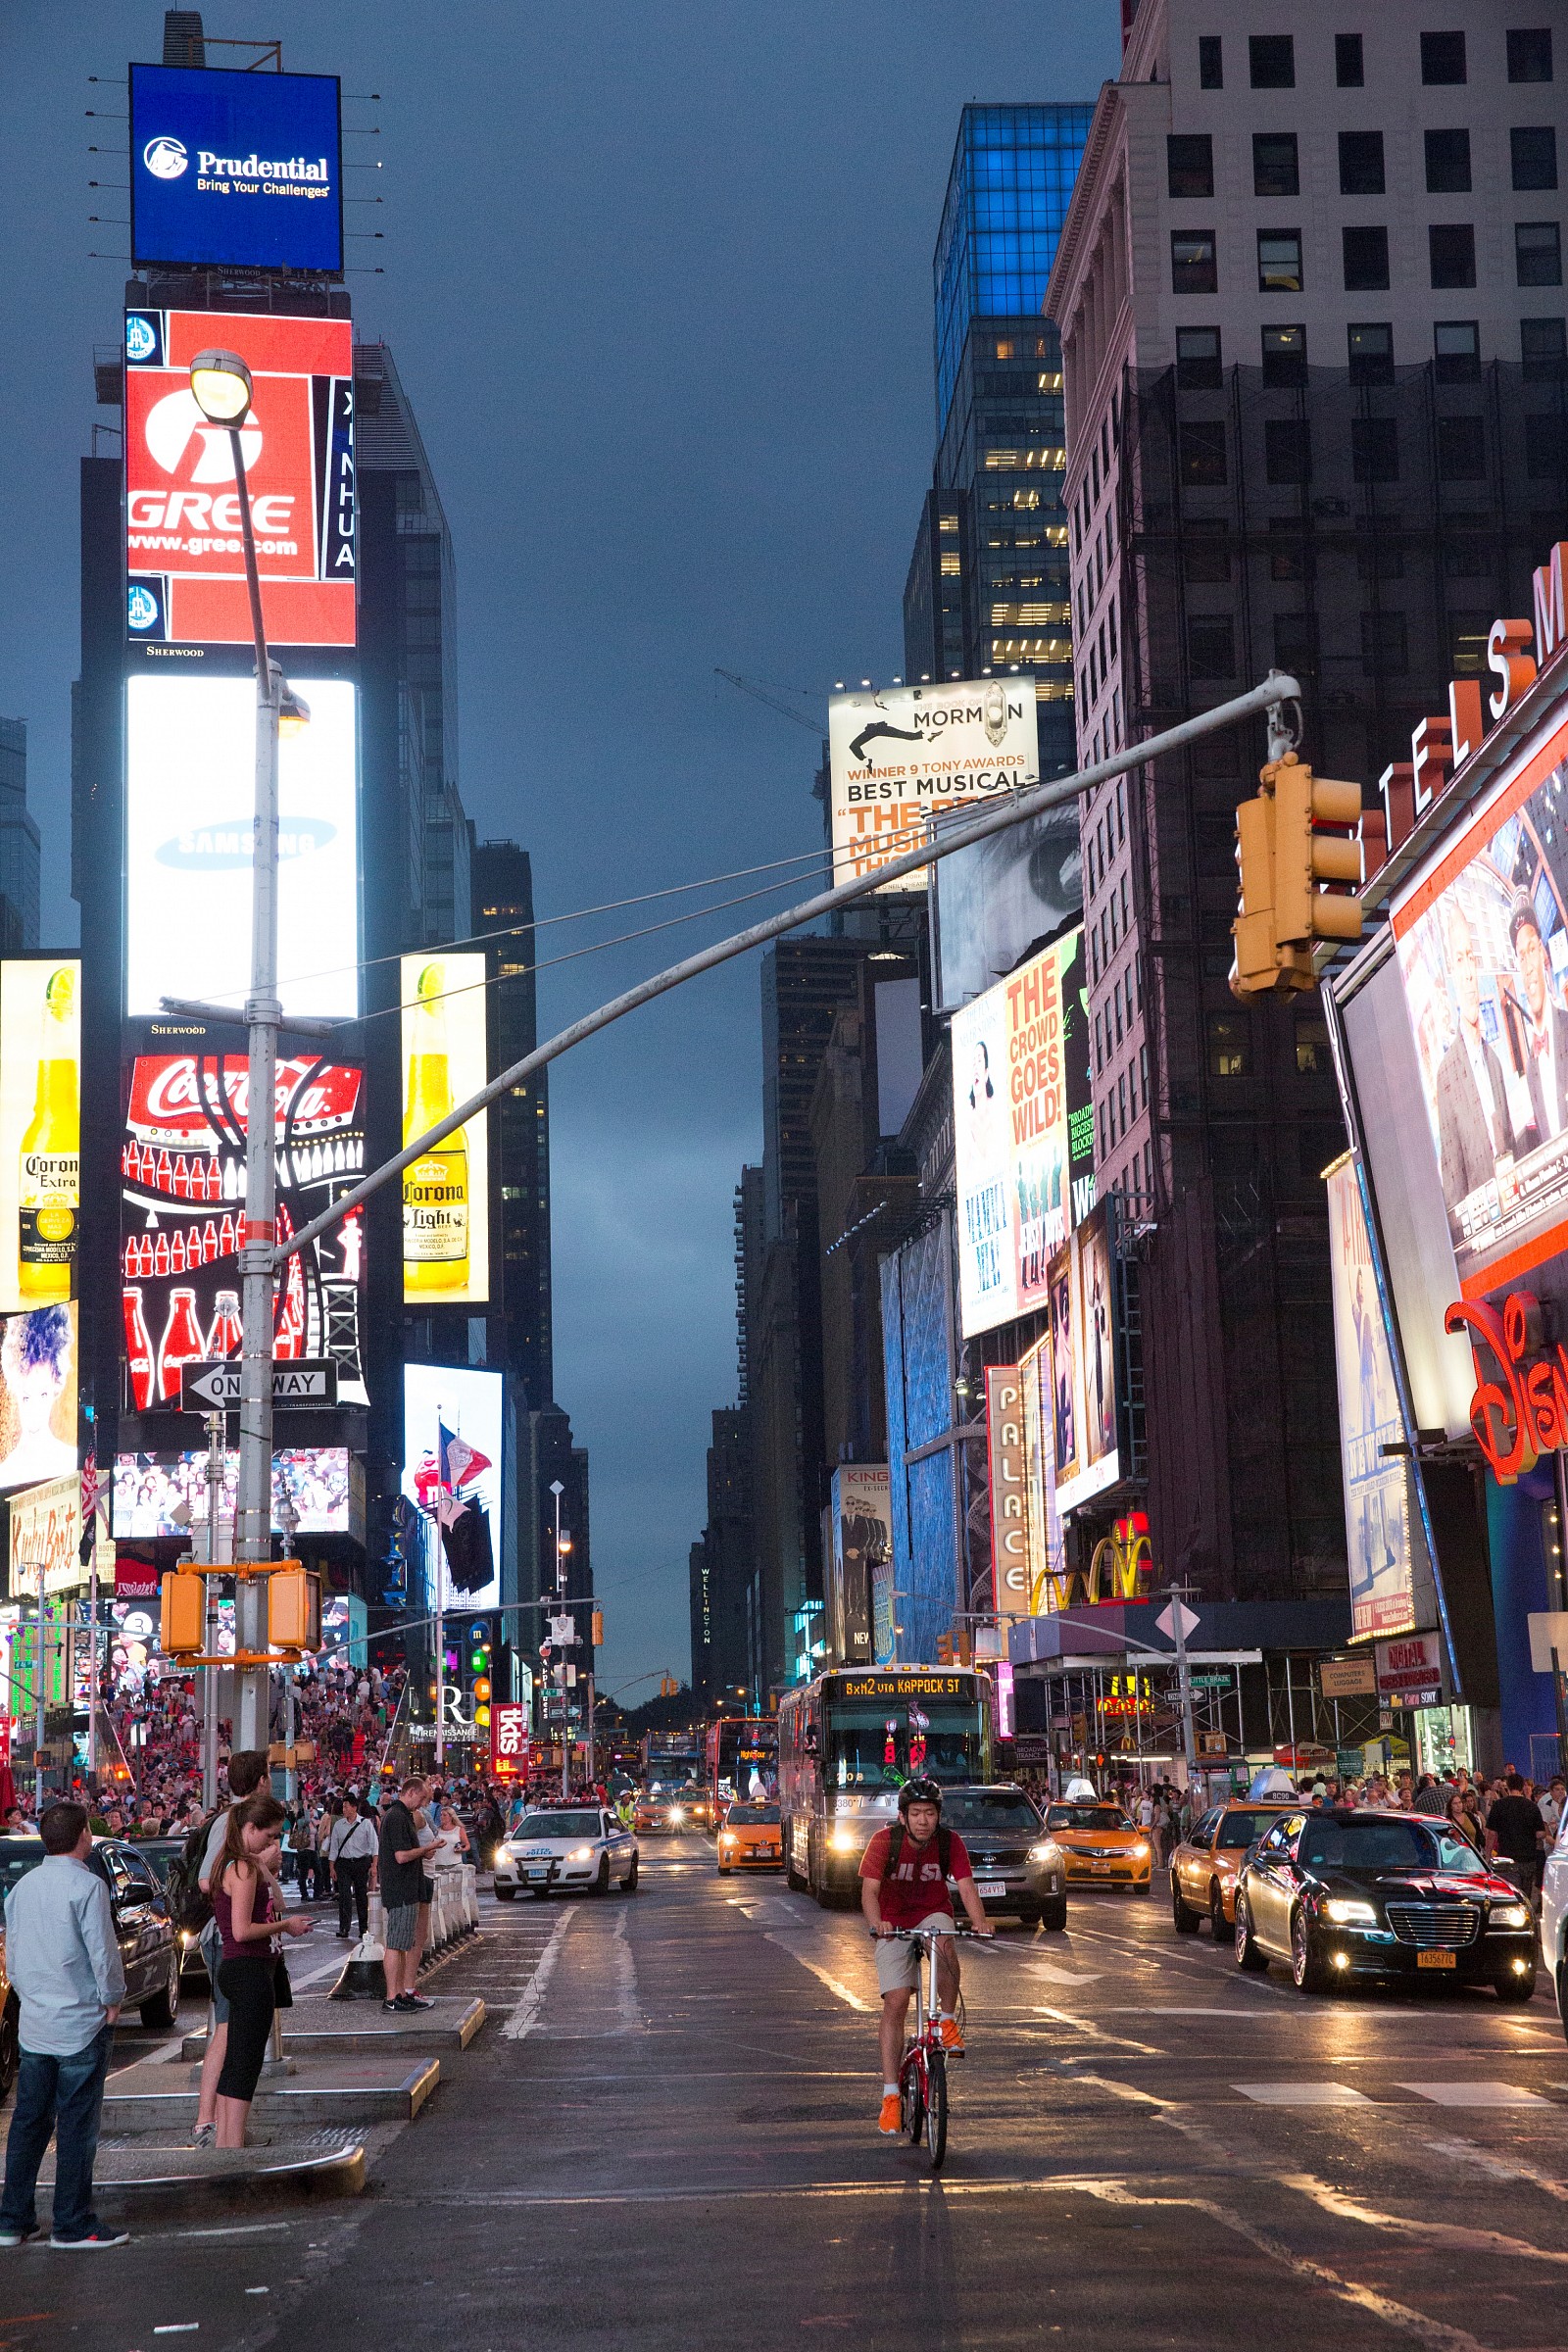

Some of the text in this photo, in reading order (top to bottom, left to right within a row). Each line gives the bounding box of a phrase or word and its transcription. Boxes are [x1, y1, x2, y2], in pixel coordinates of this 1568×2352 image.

[197, 151, 328, 181] Prudential
[197, 179, 329, 199] Bring Your Challenges
[127, 490, 295, 533] GREE
[127, 534, 297, 556] www.gree.com
[147, 646, 204, 658] SHERWOOD
[848, 755, 1025, 781] WINNER 9 TONY AWARDS
[848, 770, 1026, 802] BEST MUSICAL
[178, 832, 316, 855] SAMSNG
[1007, 956, 1058, 1033] THE
[151, 1025, 206, 1035] SHERWOOD
[1008, 1013, 1058, 1065] CROWD
[1010, 1049, 1060, 1104] GOES
[1011, 1093, 1062, 1146] WILD!
[40, 1175, 76, 1187] Extra
[403, 1181, 465, 1207] Corona
[412, 1208, 451, 1229] Light
[211, 1374, 316, 1396] ON WAY
[1000, 1386, 1025, 1591] PALACE
[701, 1568, 710, 1643] WELLINGTON
[846, 1679, 875, 1694] BxM2
[897, 1679, 944, 1693] KAPPOCK
[947, 1679, 959, 1692] ST
[1329, 1670, 1365, 1679] COMPUTERS
[1334, 1678, 1363, 1687] LUGGAGE
[434, 1685, 475, 1725] R
[1420, 1691, 1437, 1704] SONY
[500, 1708, 523, 1754] tkts
